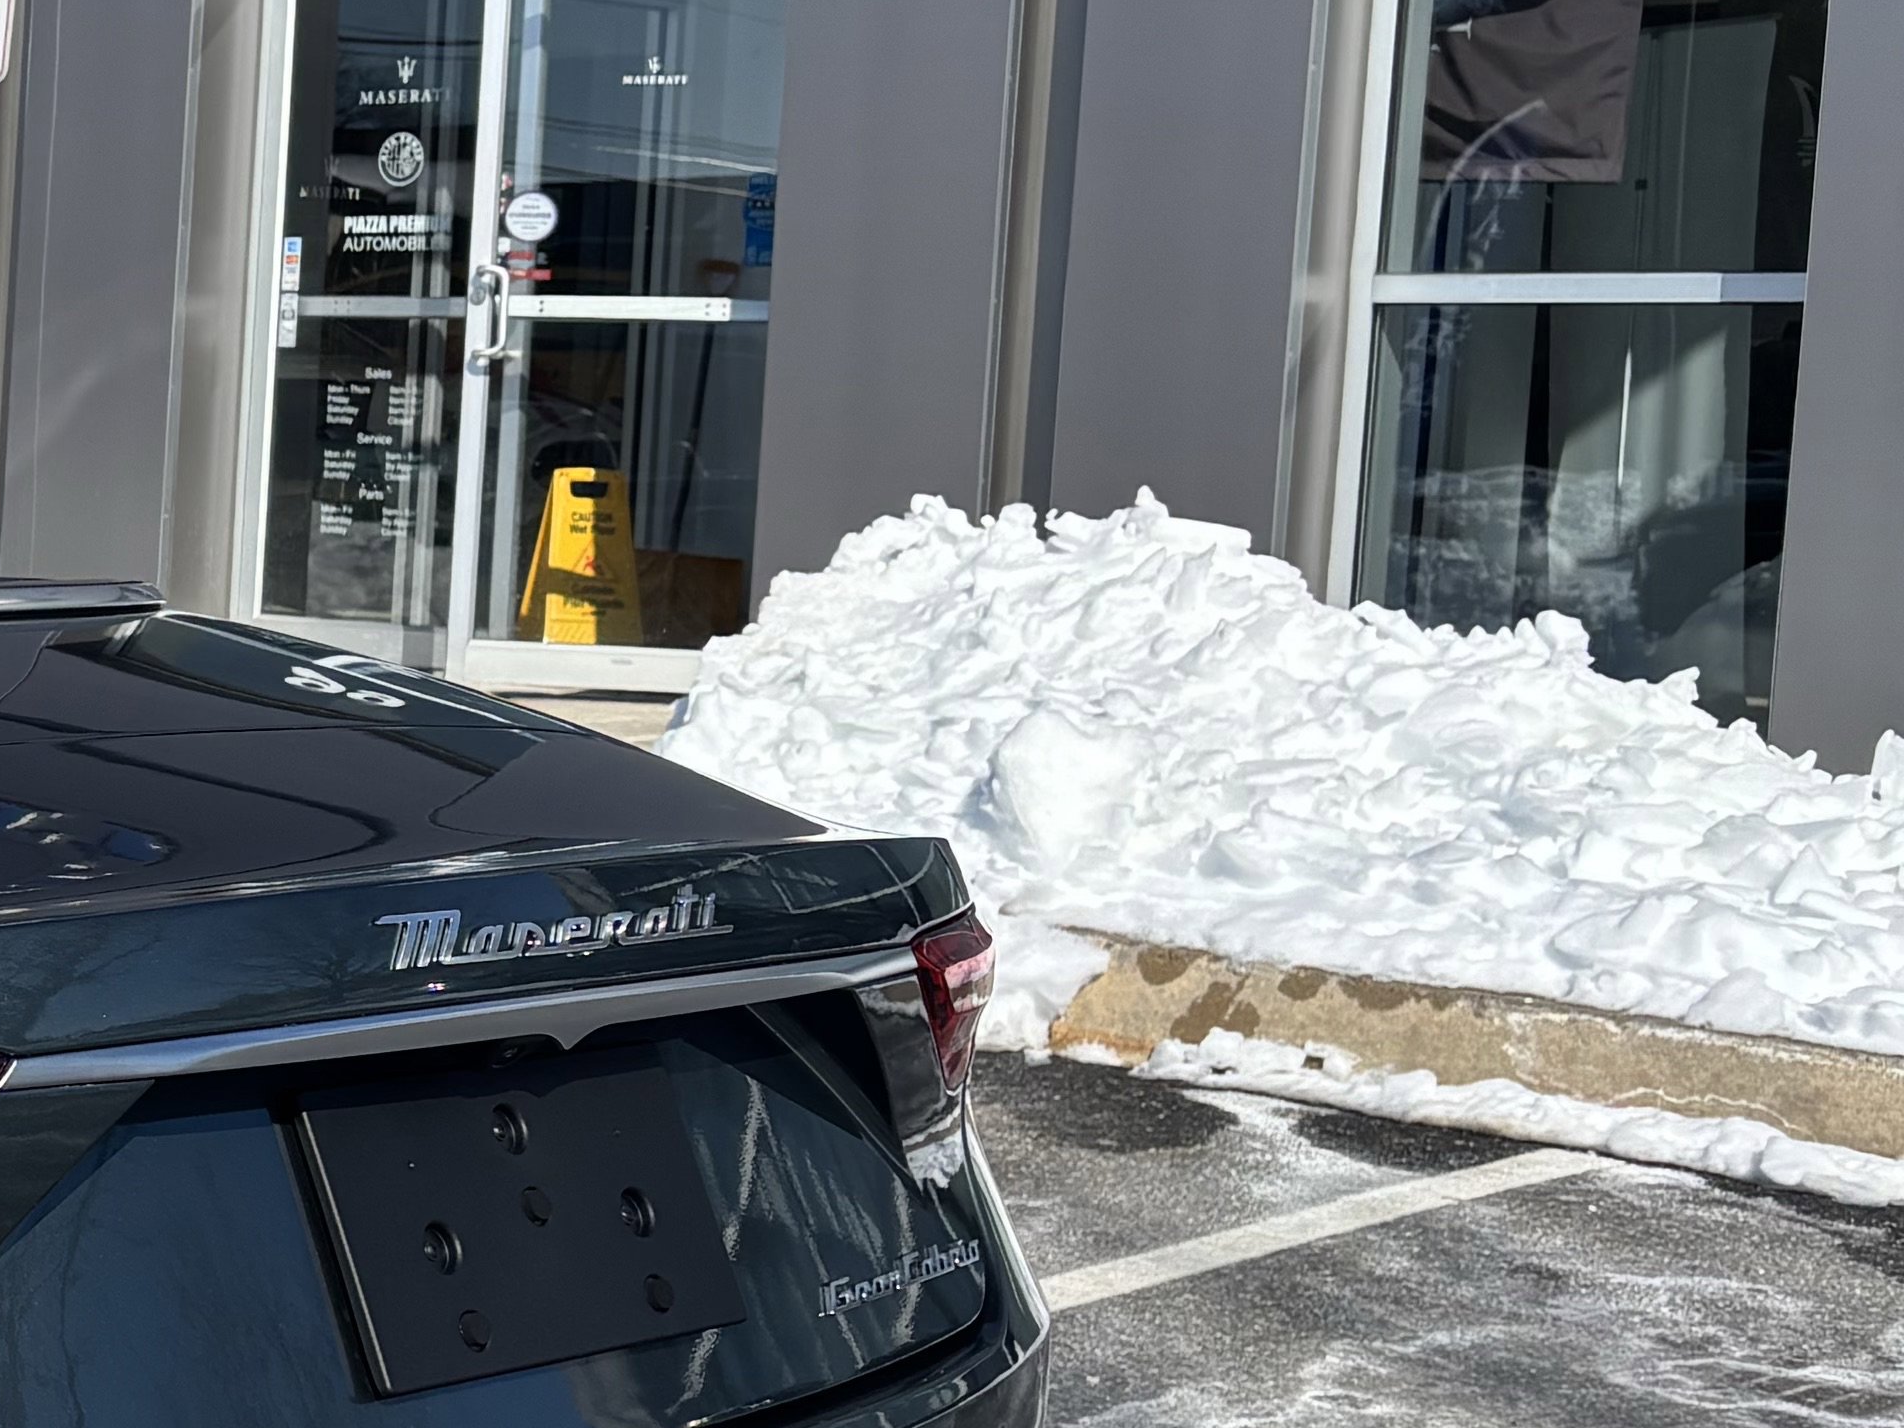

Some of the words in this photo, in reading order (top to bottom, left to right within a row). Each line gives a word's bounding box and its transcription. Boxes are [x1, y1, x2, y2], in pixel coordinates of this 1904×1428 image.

[358, 88, 451, 106] MASERATI
[343, 214, 388, 234] PIAZZA
[342, 235, 452, 253] AUTOMOBIL
[356, 431, 393, 445] Service
[358, 487, 385, 501] Parts
[570, 524, 588, 535] Wet
[376, 884, 733, 970] Maserati
